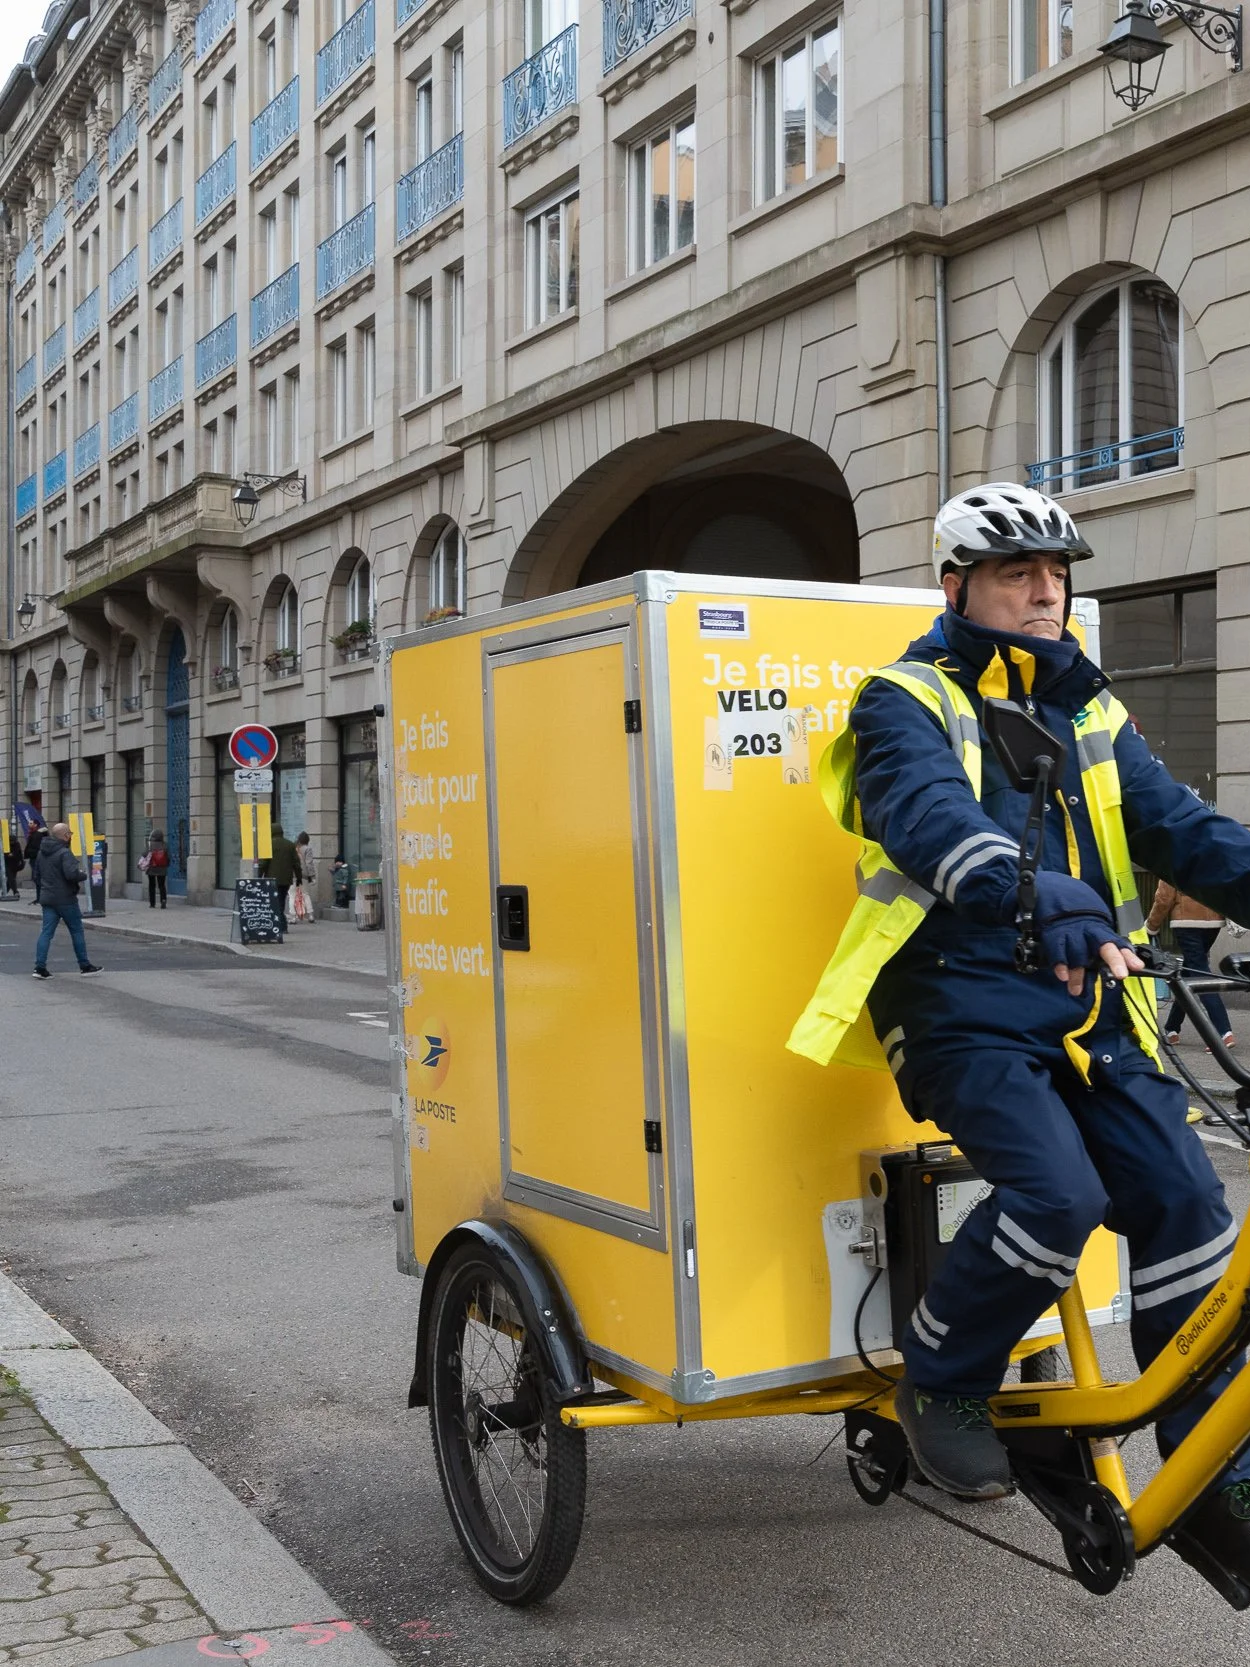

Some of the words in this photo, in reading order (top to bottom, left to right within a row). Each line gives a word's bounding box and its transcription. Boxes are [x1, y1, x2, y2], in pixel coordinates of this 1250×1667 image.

[702, 653, 747, 687] Je
[755, 654, 821, 688] fais
[829, 660, 874, 690] to
[717, 688, 788, 713] VELO
[401, 719, 417, 752] Je
[420, 710, 449, 750] fais
[733, 732, 783, 757] 203
[401, 772, 434, 806] tout
[438, 773, 479, 813] pour
[438, 823, 453, 860] le
[405, 878, 449, 916] trafic
[408, 939, 448, 972] reste
[450, 942, 490, 977] vert.
[414, 1096, 427, 1115] LA
[427, 1100, 456, 1124] POSTE
[1175, 1292, 1228, 1356] Radkutsche
